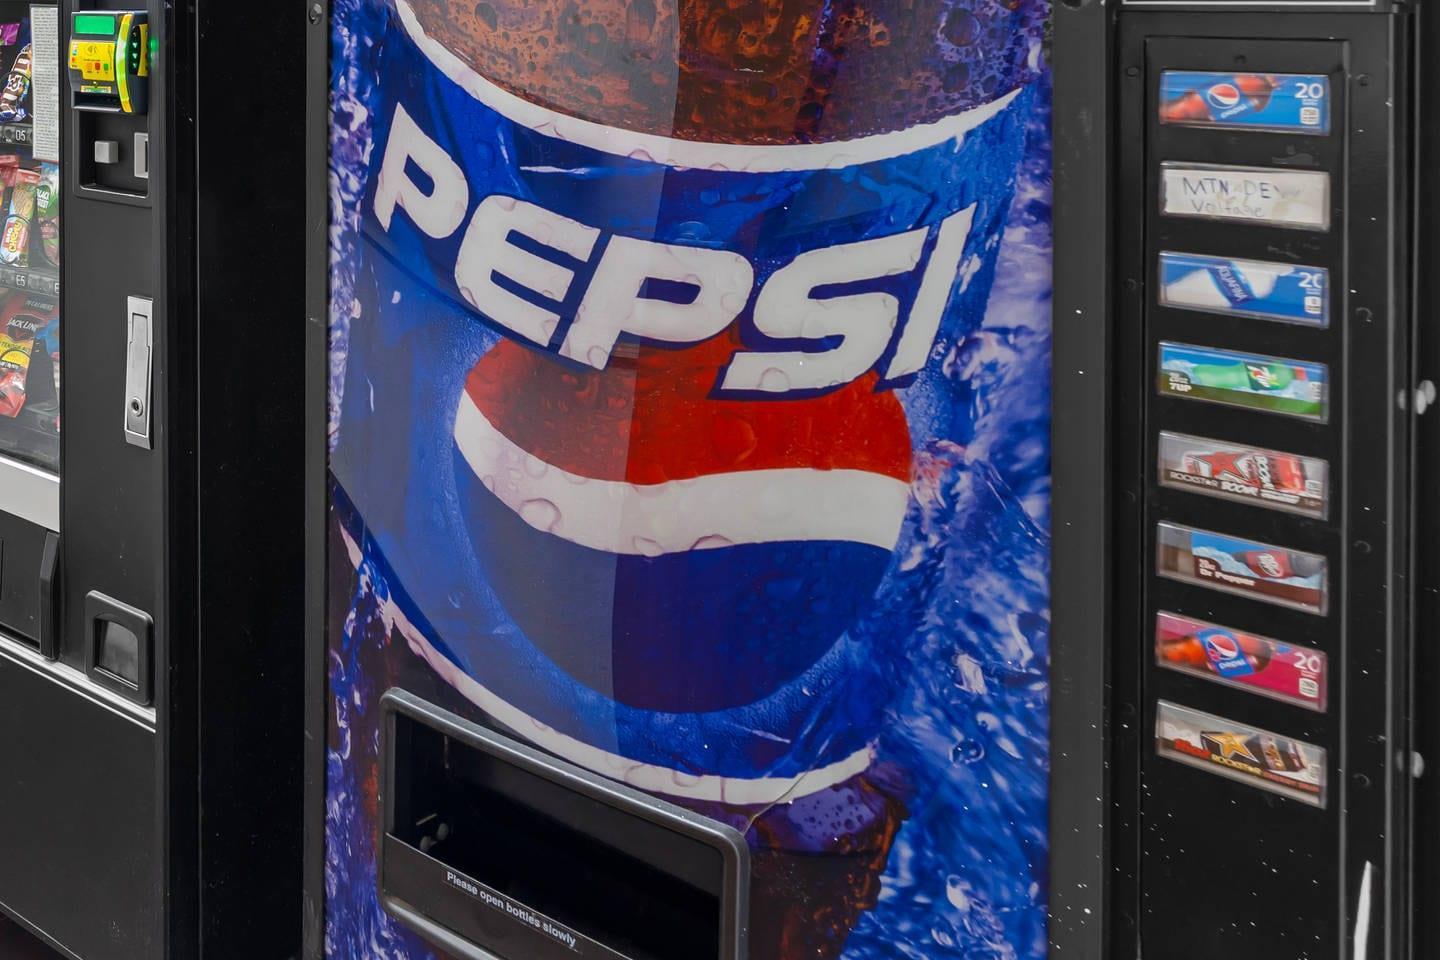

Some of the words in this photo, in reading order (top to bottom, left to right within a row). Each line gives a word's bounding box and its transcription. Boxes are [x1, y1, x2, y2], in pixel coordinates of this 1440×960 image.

[1294, 82, 1324, 99] 20
[1183, 176, 1229, 195] MTN
[375, 102, 978, 393] PEPSI
[1216, 265, 1249, 302] AQUAFINA
[1293, 652, 1321, 673] 20
[447, 871, 478, 895] Please
[480, 890, 504, 908] open
[506, 902, 541, 928] bottles
[543, 922, 576, 947] slowly
